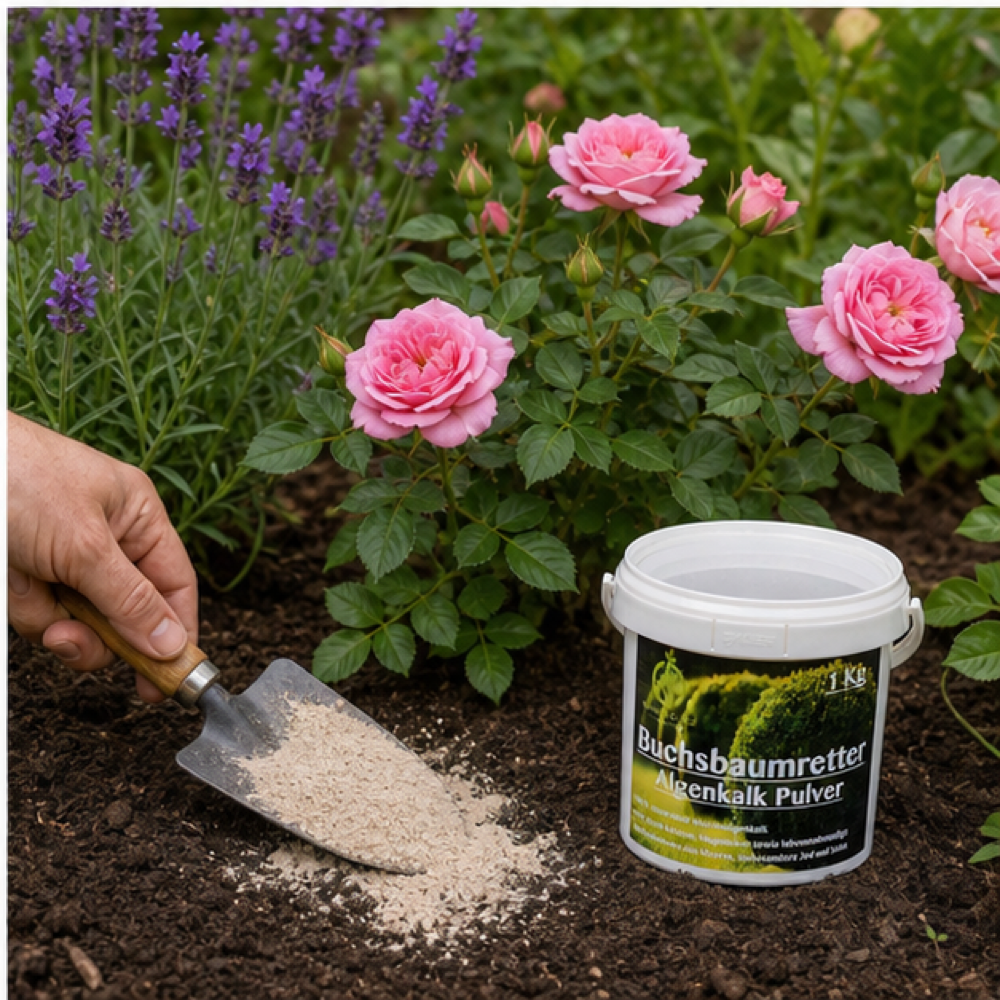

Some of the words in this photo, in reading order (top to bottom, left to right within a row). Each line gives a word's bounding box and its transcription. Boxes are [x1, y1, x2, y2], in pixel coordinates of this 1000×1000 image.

[829, 671, 836, 690] 1
[637, 724, 867, 778] Buchsbaumretter
[655, 769, 768, 807] Algenkalk
[775, 781, 844, 806] Pulver
